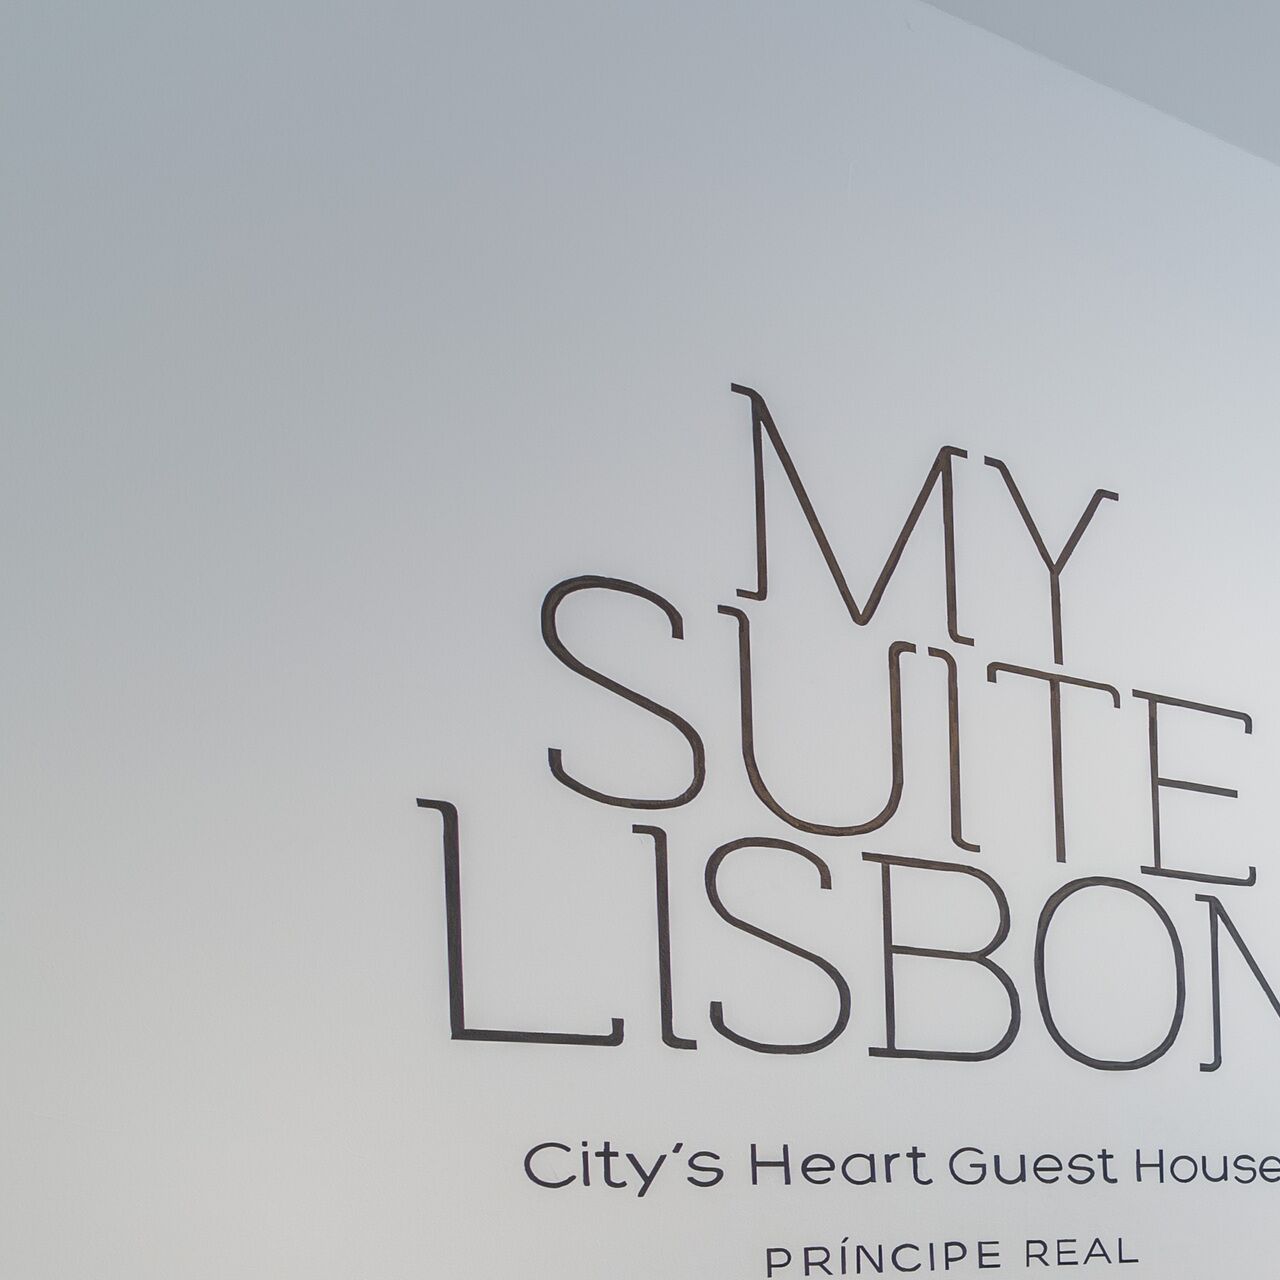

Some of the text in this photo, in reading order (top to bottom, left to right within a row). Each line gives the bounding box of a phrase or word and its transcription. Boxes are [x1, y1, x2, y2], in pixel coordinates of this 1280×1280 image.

[730, 382, 1119, 665] MY
[541, 574, 1257, 887] SUITE
[523, 1141, 725, 1198] City's
[750, 1143, 934, 1187] Heart
[948, 1146, 1119, 1186] Guest
[766, 1236, 1140, 1279] PRÍNCIPE REAL
